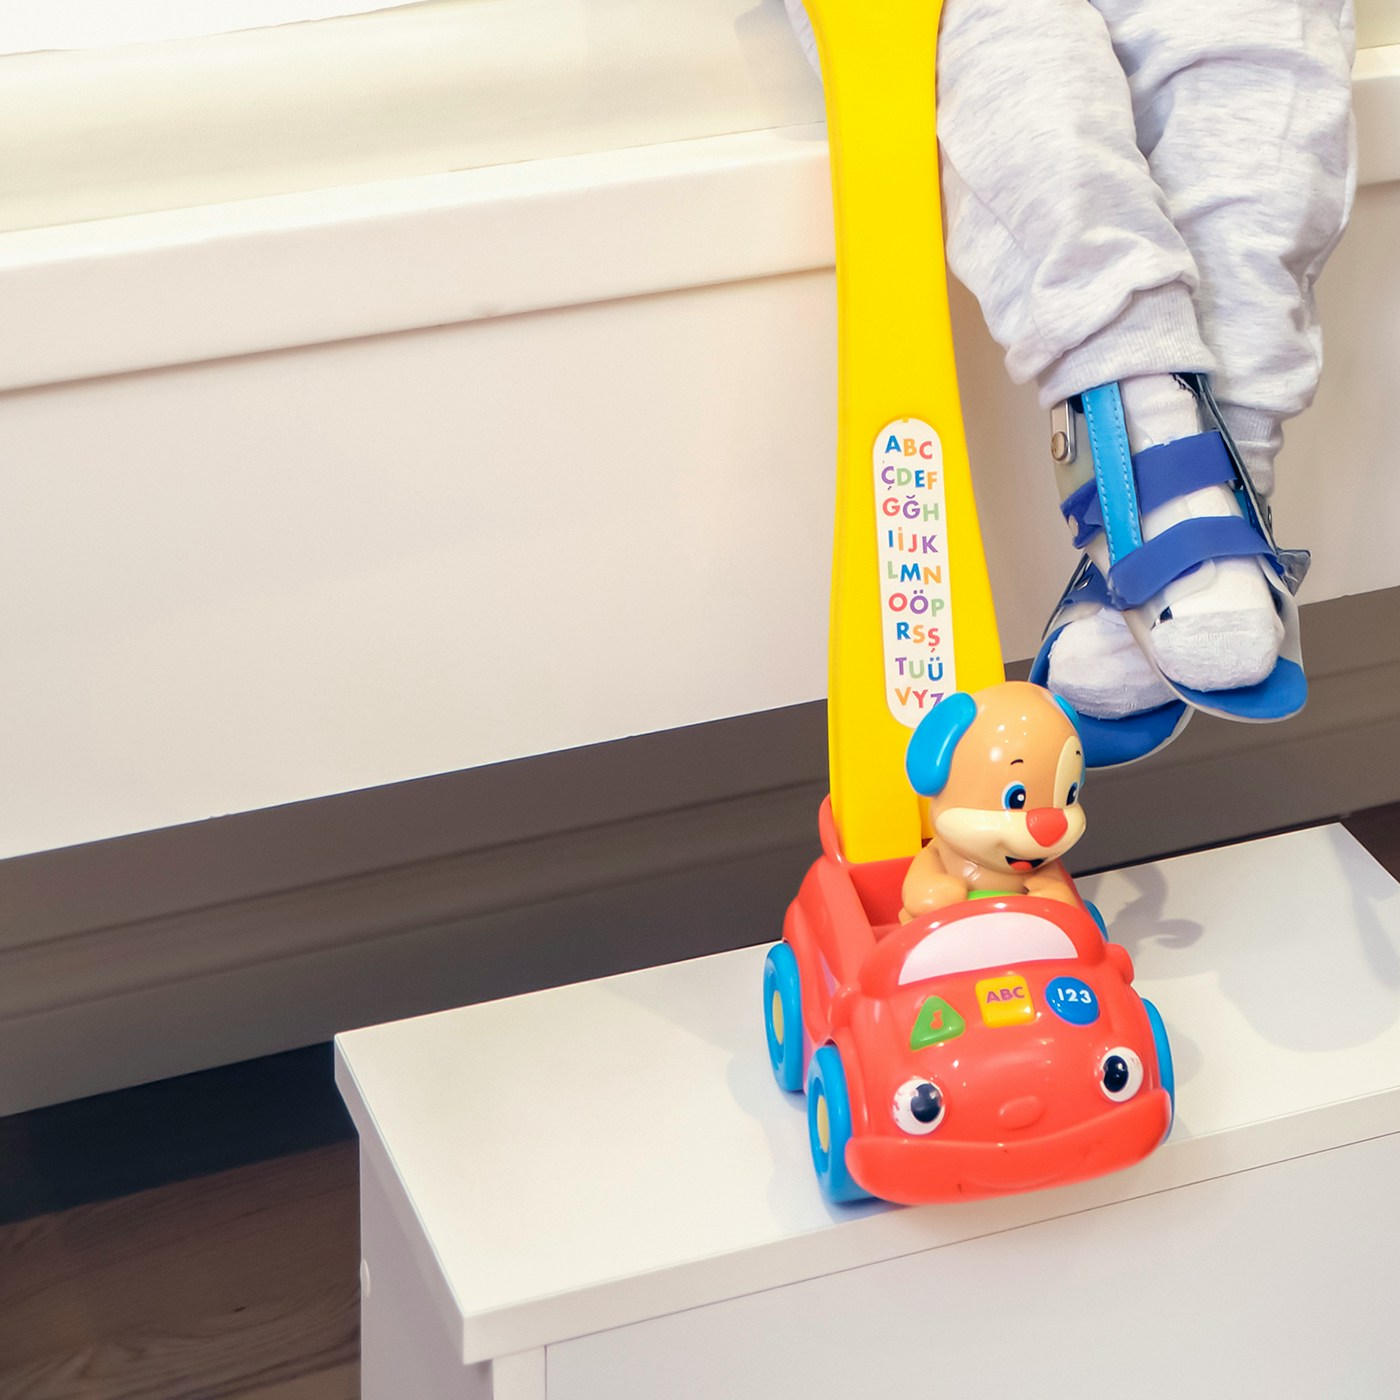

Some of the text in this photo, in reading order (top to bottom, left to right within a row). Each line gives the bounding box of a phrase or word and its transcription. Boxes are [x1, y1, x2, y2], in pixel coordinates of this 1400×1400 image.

[884, 434, 933, 460] ABC
[881, 466, 938, 491] ÇDEF
[882, 495, 940, 521] GĞH
[888, 526, 938, 554] IİJK
[888, 561, 942, 585] LMN
[888, 590, 945, 617] OÖP
[896, 622, 940, 653] RSŞ
[895, 657, 944, 682] TUÜ
[986, 986, 1025, 1003] ABC
[1057, 988, 1092, 1004] 123
